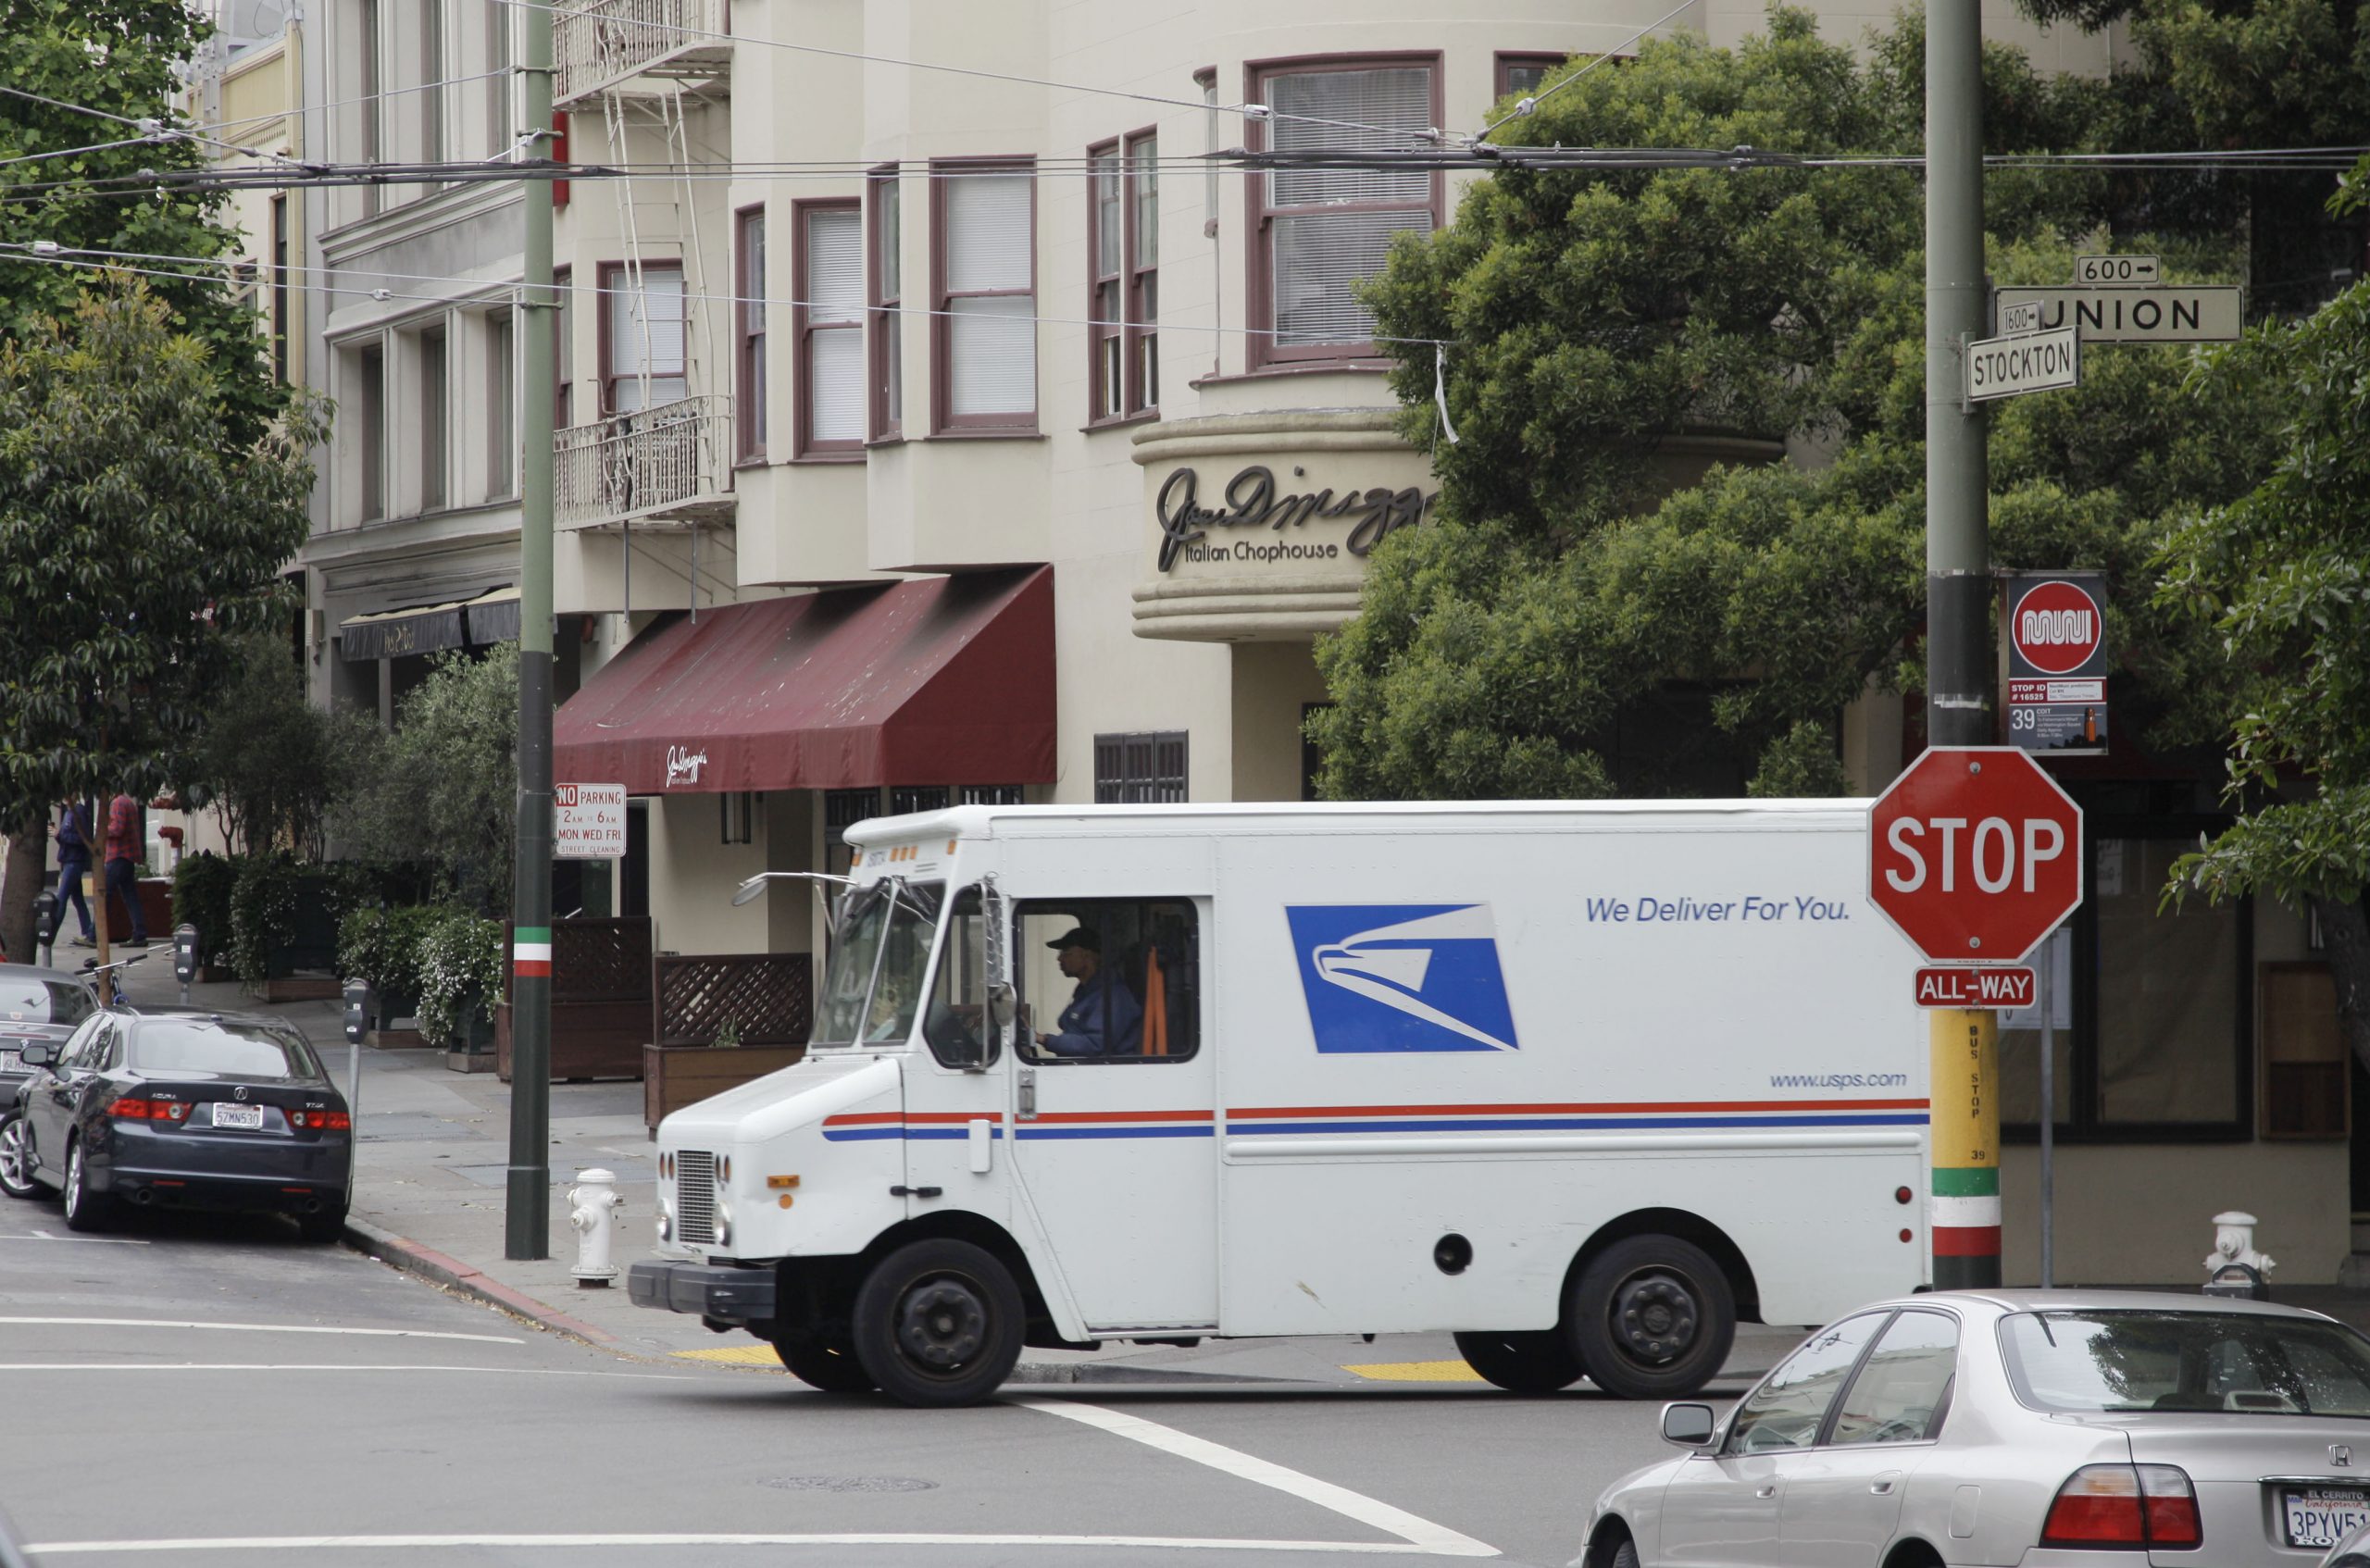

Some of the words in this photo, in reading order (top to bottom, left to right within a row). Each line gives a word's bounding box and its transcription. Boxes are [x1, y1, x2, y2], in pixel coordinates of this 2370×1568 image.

[2085, 260, 2131, 280] 600
[2004, 308, 2027, 330] 1600
[2043, 299, 2199, 330] UNION
[1975, 341, 2070, 386] STOCKTON
[1185, 542, 1230, 563] Italian
[1234, 541, 1339, 564] Chophouse
[2022, 609, 2092, 645] MUNI
[2012, 684, 2035, 692] STOP
[2037, 684, 2046, 692] ID
[2012, 709, 2036, 730] 39
[557, 787, 576, 805] NO
[580, 791, 621, 805] PARKING
[564, 809, 571, 823] 2
[597, 810, 605, 824] 6
[590, 845, 620, 853] CLEANING
[1885, 816, 2064, 894] STOP
[1586, 898, 1629, 922] We
[1636, 897, 1736, 922] Deliver
[1741, 896, 1789, 921] For
[1793, 896, 1851, 921] You.
[1919, 976, 2030, 1000] ALL-WAY
[1969, 1025, 1978, 1060] BUS
[1770, 1073, 1907, 1091] www.usps.com
[1970, 1073, 1979, 1119] STOP
[217, 1111, 259, 1126] 5ZMN530
[1970, 1150, 1986, 1160] 39
[2304, 1497, 2366, 1512] California
[2308, 1489, 2320, 1500] EL
[2321, 1490, 2364, 1500] CERRITO
